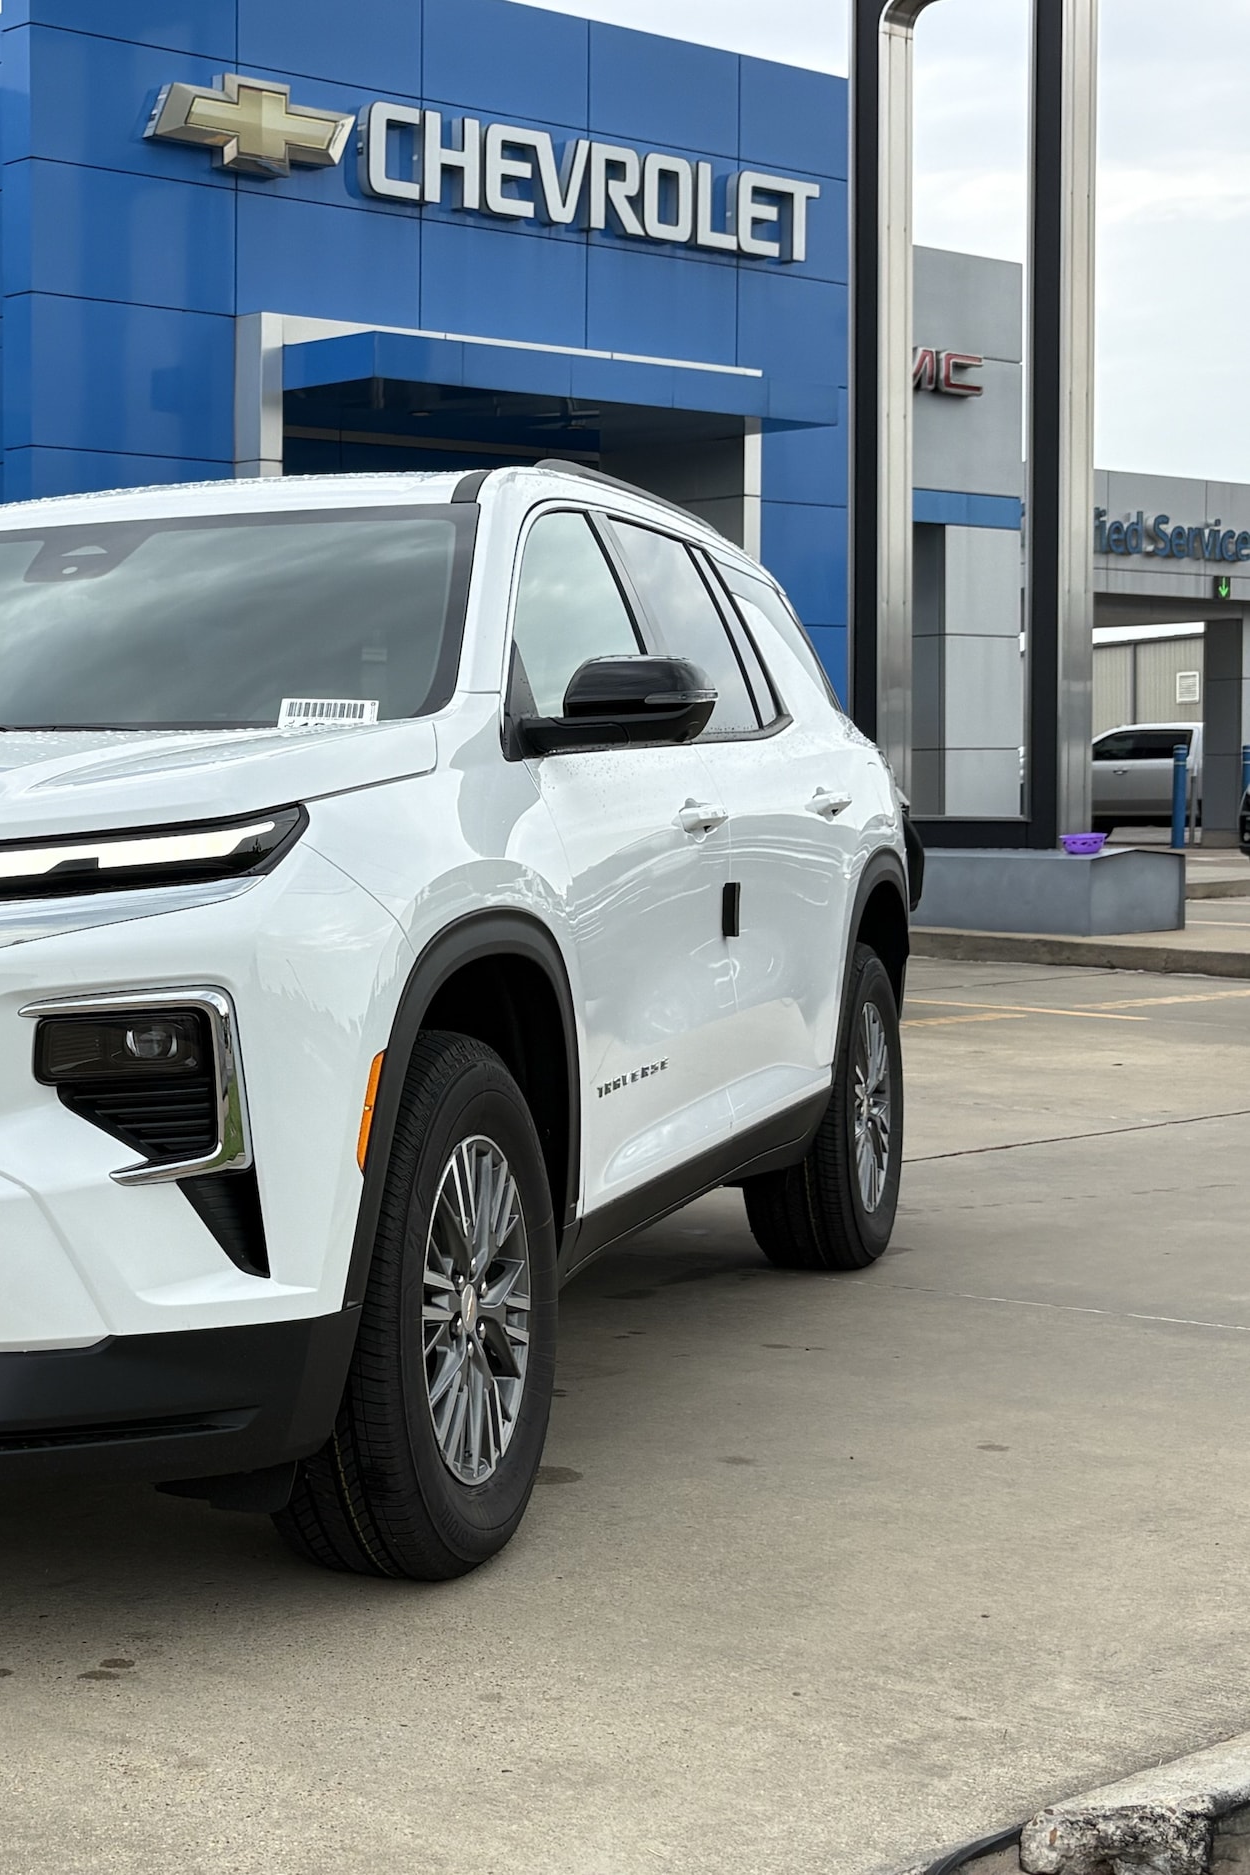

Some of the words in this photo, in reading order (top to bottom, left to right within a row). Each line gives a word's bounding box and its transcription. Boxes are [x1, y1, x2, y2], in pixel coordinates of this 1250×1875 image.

[357, 100, 821, 263] CHEVROLET
[912, 347, 983, 396] MC
[1147, 513, 1250, 562] Service
